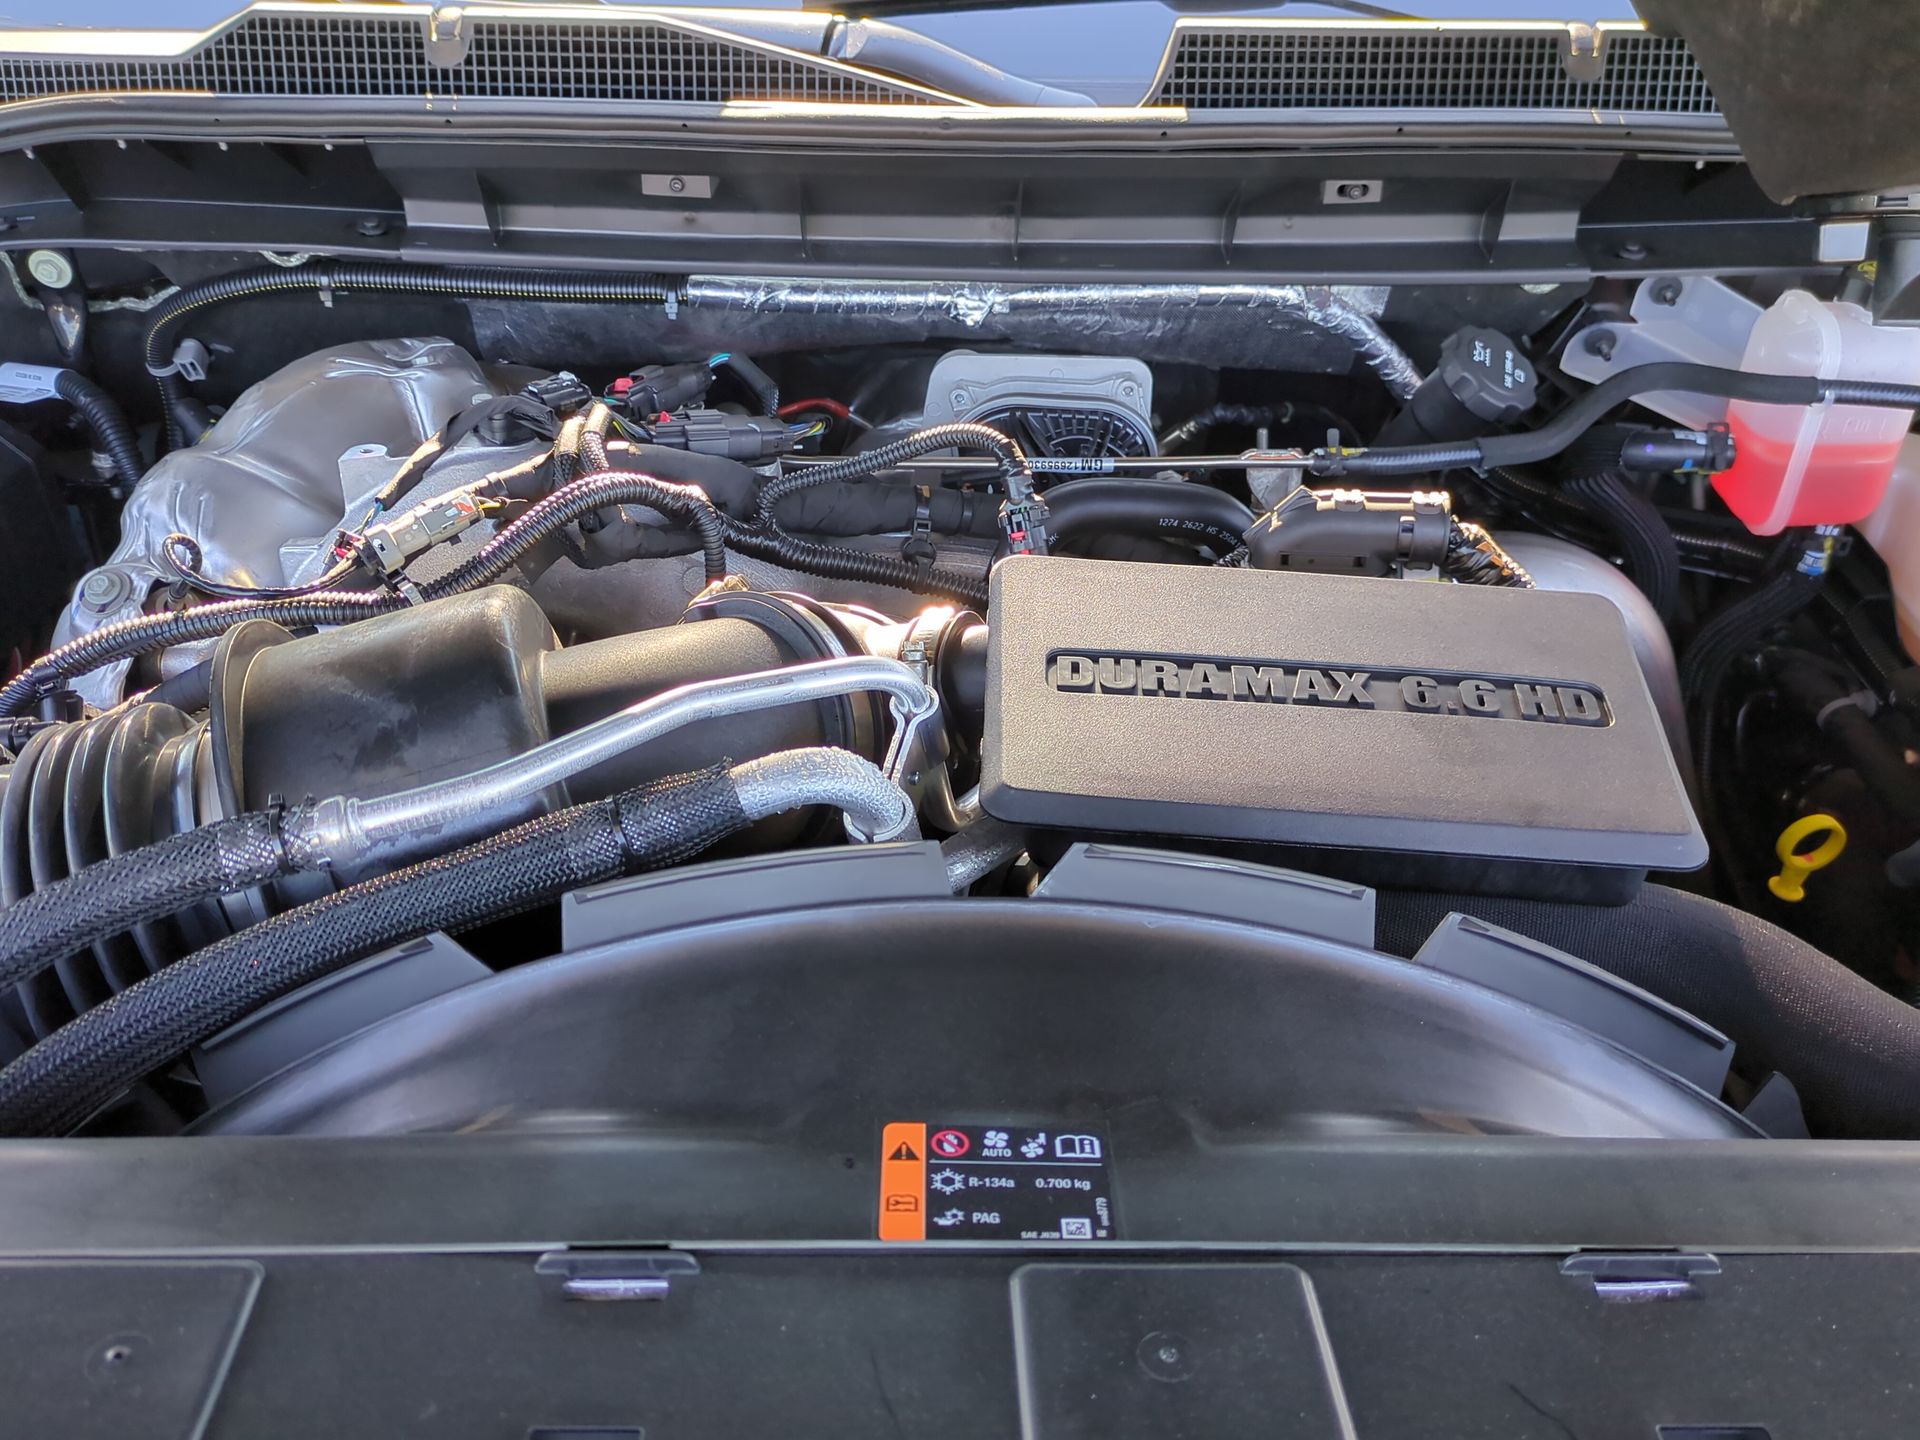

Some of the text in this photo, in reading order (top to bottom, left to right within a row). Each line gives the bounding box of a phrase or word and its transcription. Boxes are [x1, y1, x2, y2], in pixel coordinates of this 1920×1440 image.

[1055, 655, 1603, 726] DURAMAX 6.6 HD
[982, 1148, 1012, 1158] AUTO
[968, 1176, 1091, 1191] R-134a 0.700 kg
[972, 1212, 1000, 1224] PAG
